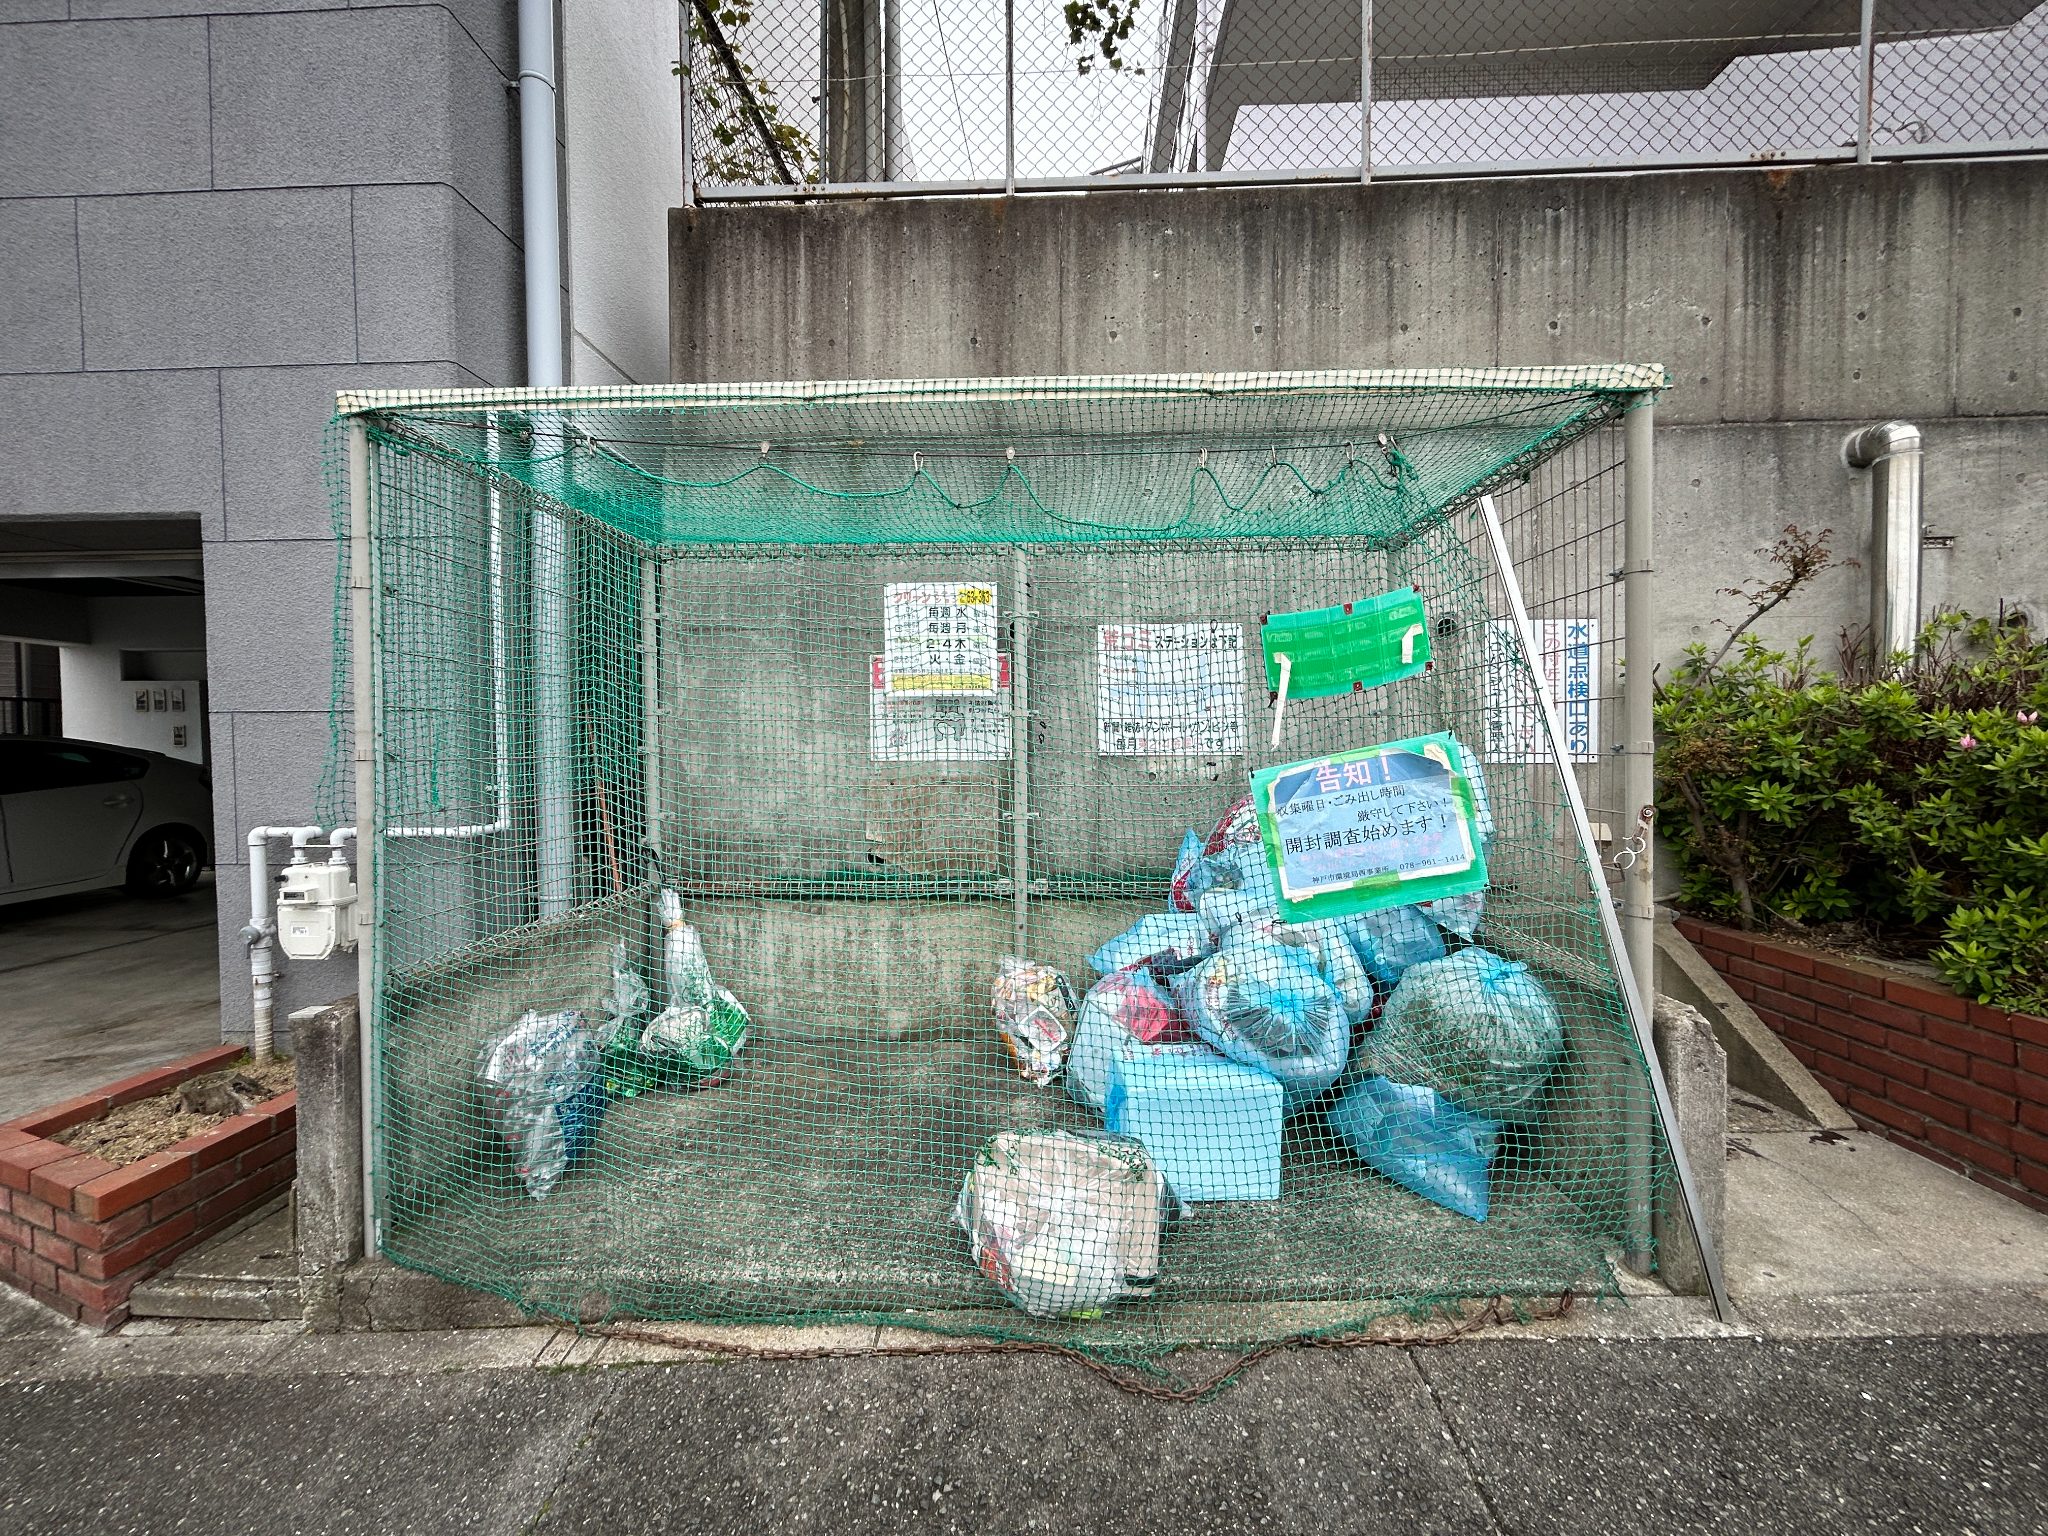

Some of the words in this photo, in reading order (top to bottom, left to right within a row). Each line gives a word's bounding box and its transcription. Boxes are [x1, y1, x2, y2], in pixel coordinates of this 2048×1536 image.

[956, 607, 967, 618] 水
[928, 622, 951, 634] 毎週
[954, 638, 967, 650] 木
[1567, 621, 1589, 755] 水道点検口あり
